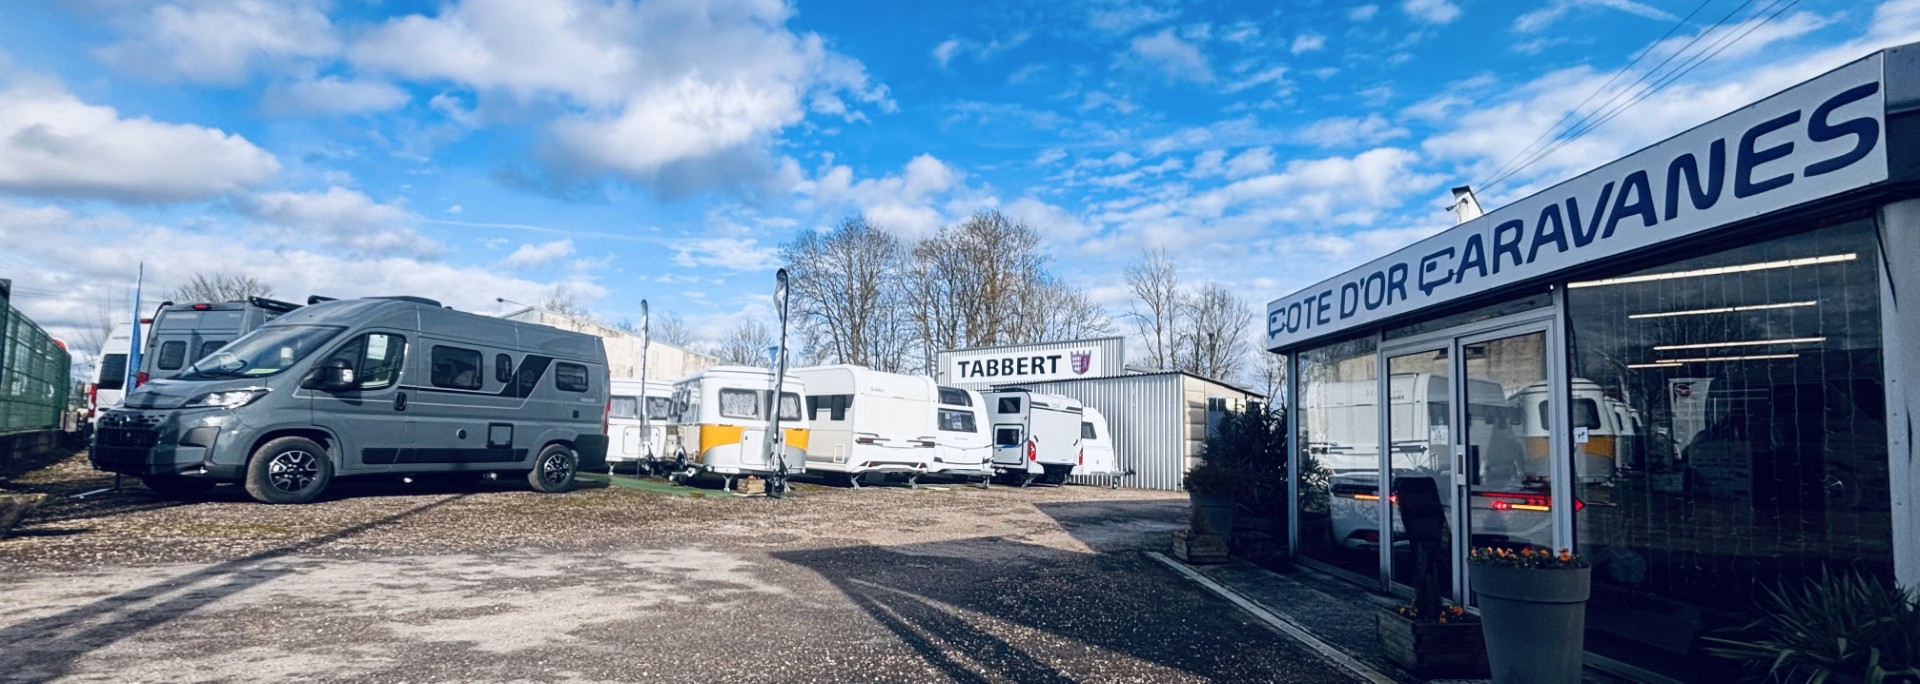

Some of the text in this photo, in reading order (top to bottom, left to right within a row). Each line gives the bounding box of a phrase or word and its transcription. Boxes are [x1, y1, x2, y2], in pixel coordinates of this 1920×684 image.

[1269, 81, 1880, 340] COTE D'OR CARAVANES
[957, 354, 1062, 378] TABBERT
